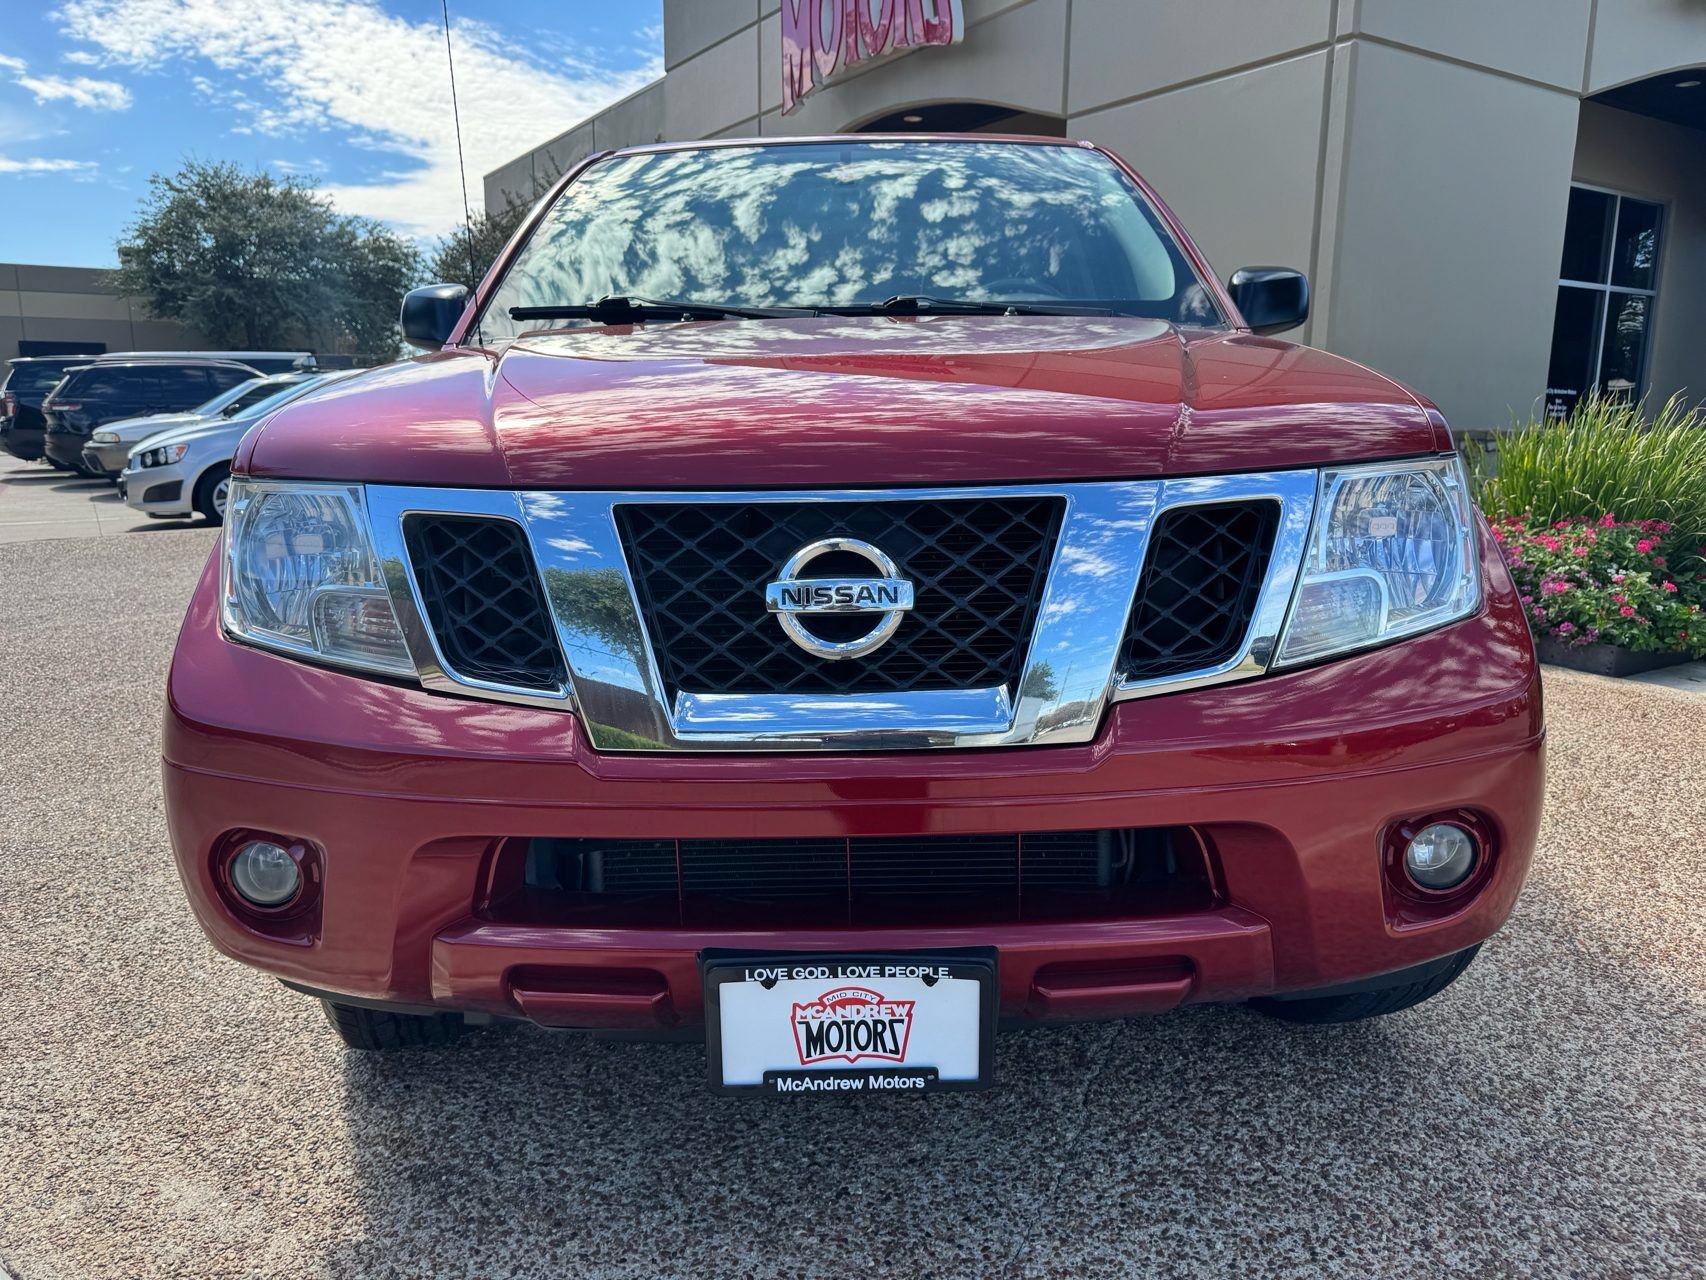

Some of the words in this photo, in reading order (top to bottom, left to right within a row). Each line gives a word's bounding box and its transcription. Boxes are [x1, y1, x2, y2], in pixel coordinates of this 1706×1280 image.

[781, 585, 898, 606] NISSAN
[745, 968, 788, 982] LOVE
[792, 966, 833, 980] GOD.
[838, 966, 880, 979] LOVE
[885, 966, 953, 979] PEOPLE.
[826, 991, 847, 1003] MID
[852, 991, 877, 1002] CITY
[797, 1018, 905, 1059] MOTORS
[777, 1076, 864, 1092] McAndrew
[868, 1075, 925, 1090] Motors
